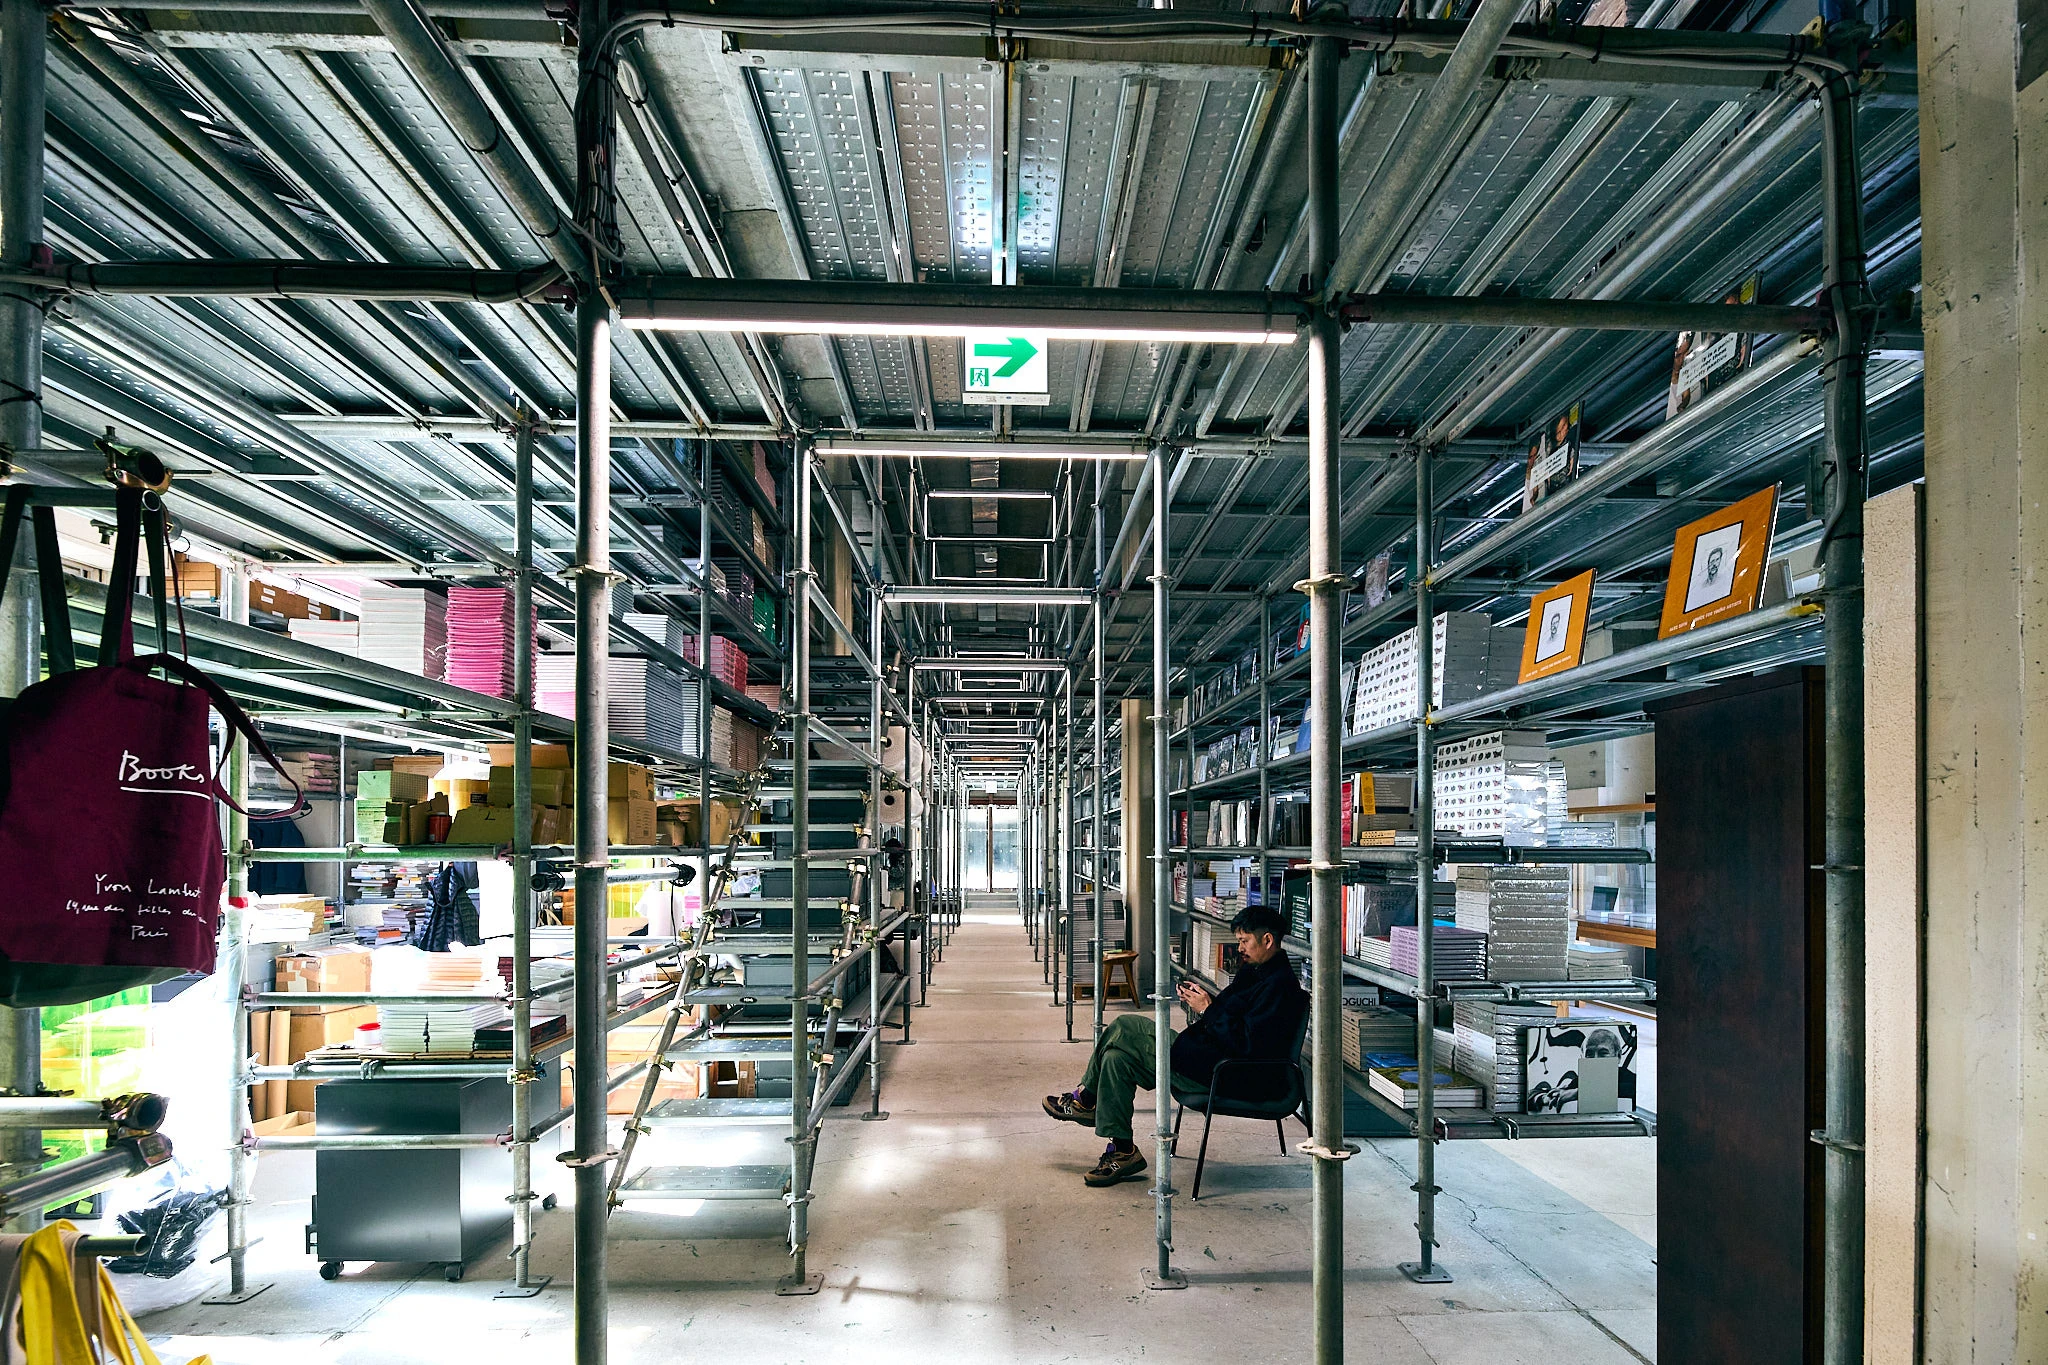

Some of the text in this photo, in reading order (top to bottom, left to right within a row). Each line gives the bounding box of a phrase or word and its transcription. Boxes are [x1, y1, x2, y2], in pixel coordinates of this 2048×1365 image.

[119, 749, 205, 784] Books
[95, 873, 132, 895] Yvon
[131, 925, 169, 941] Paris
